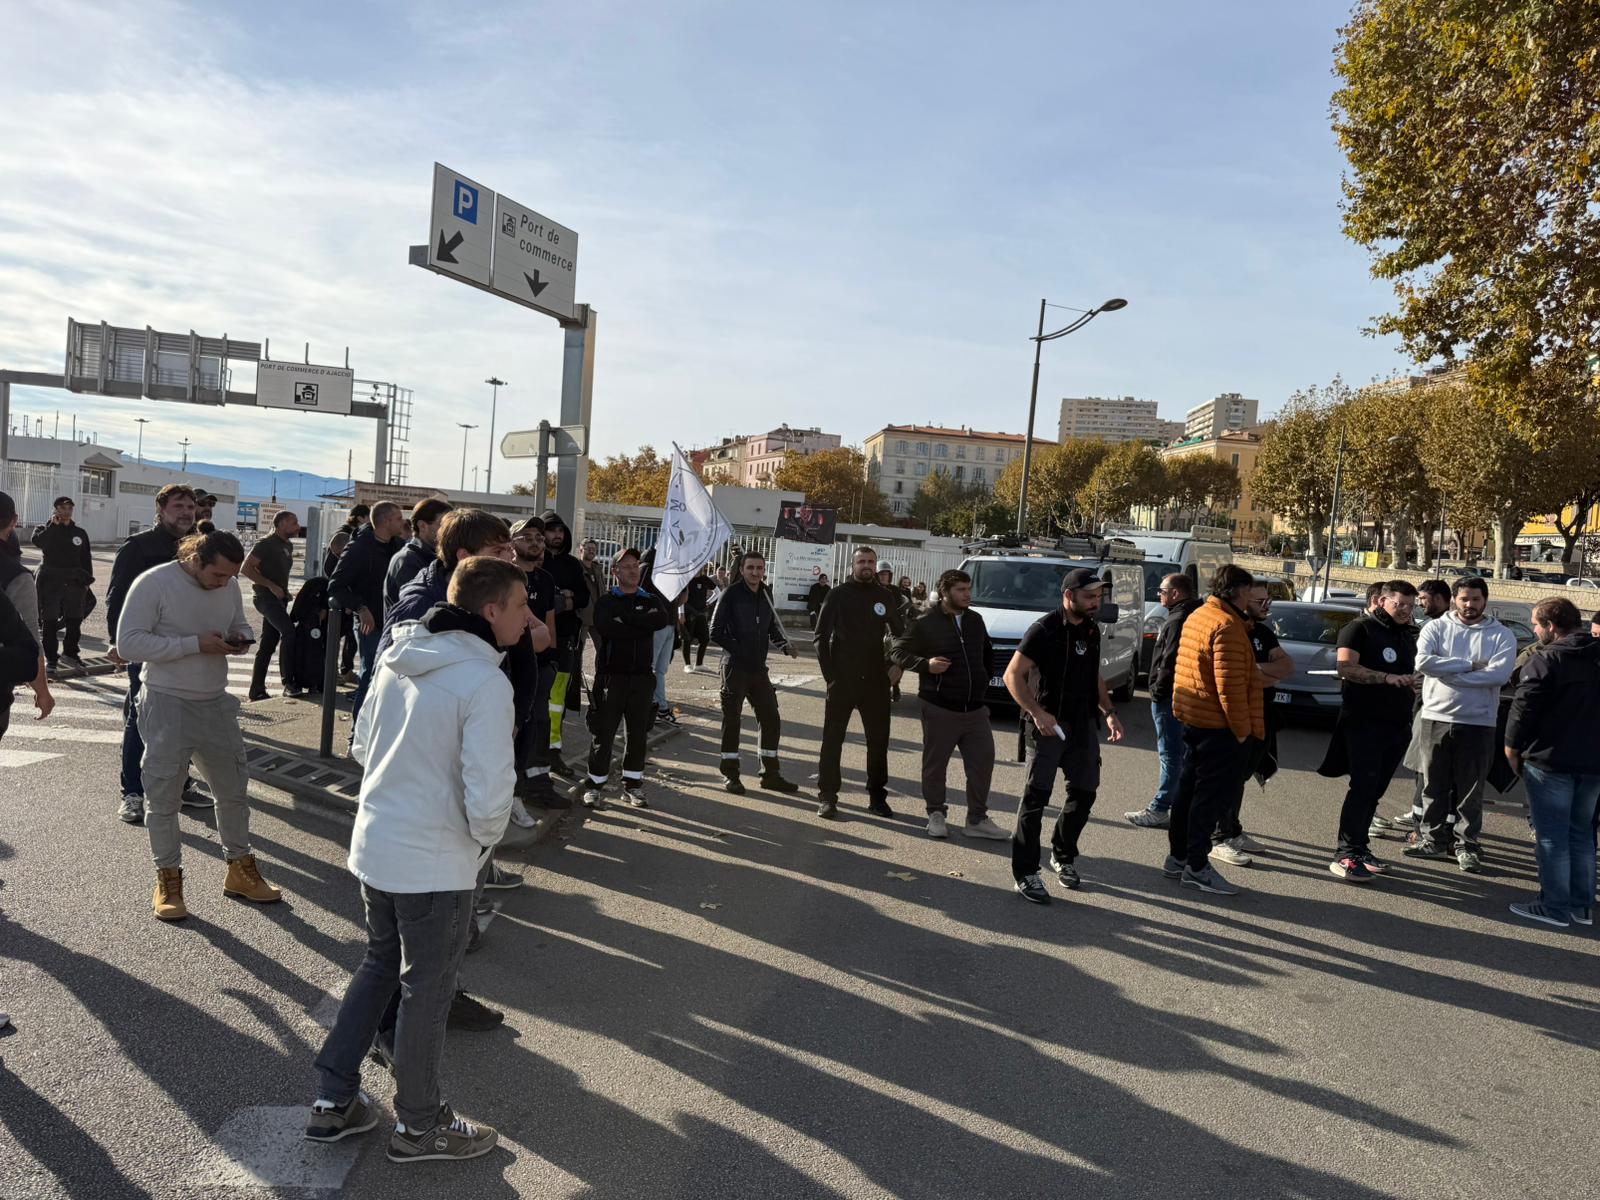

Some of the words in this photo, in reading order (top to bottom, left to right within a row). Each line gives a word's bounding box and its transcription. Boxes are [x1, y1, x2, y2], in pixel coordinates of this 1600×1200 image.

[459, 187, 473, 214] P
[520, 214, 543, 238] Port
[547, 229, 560, 245] de
[519, 239, 573, 272] commerce
[260, 363, 275, 371] PORT
[286, 366, 319, 375] COMMERCE
